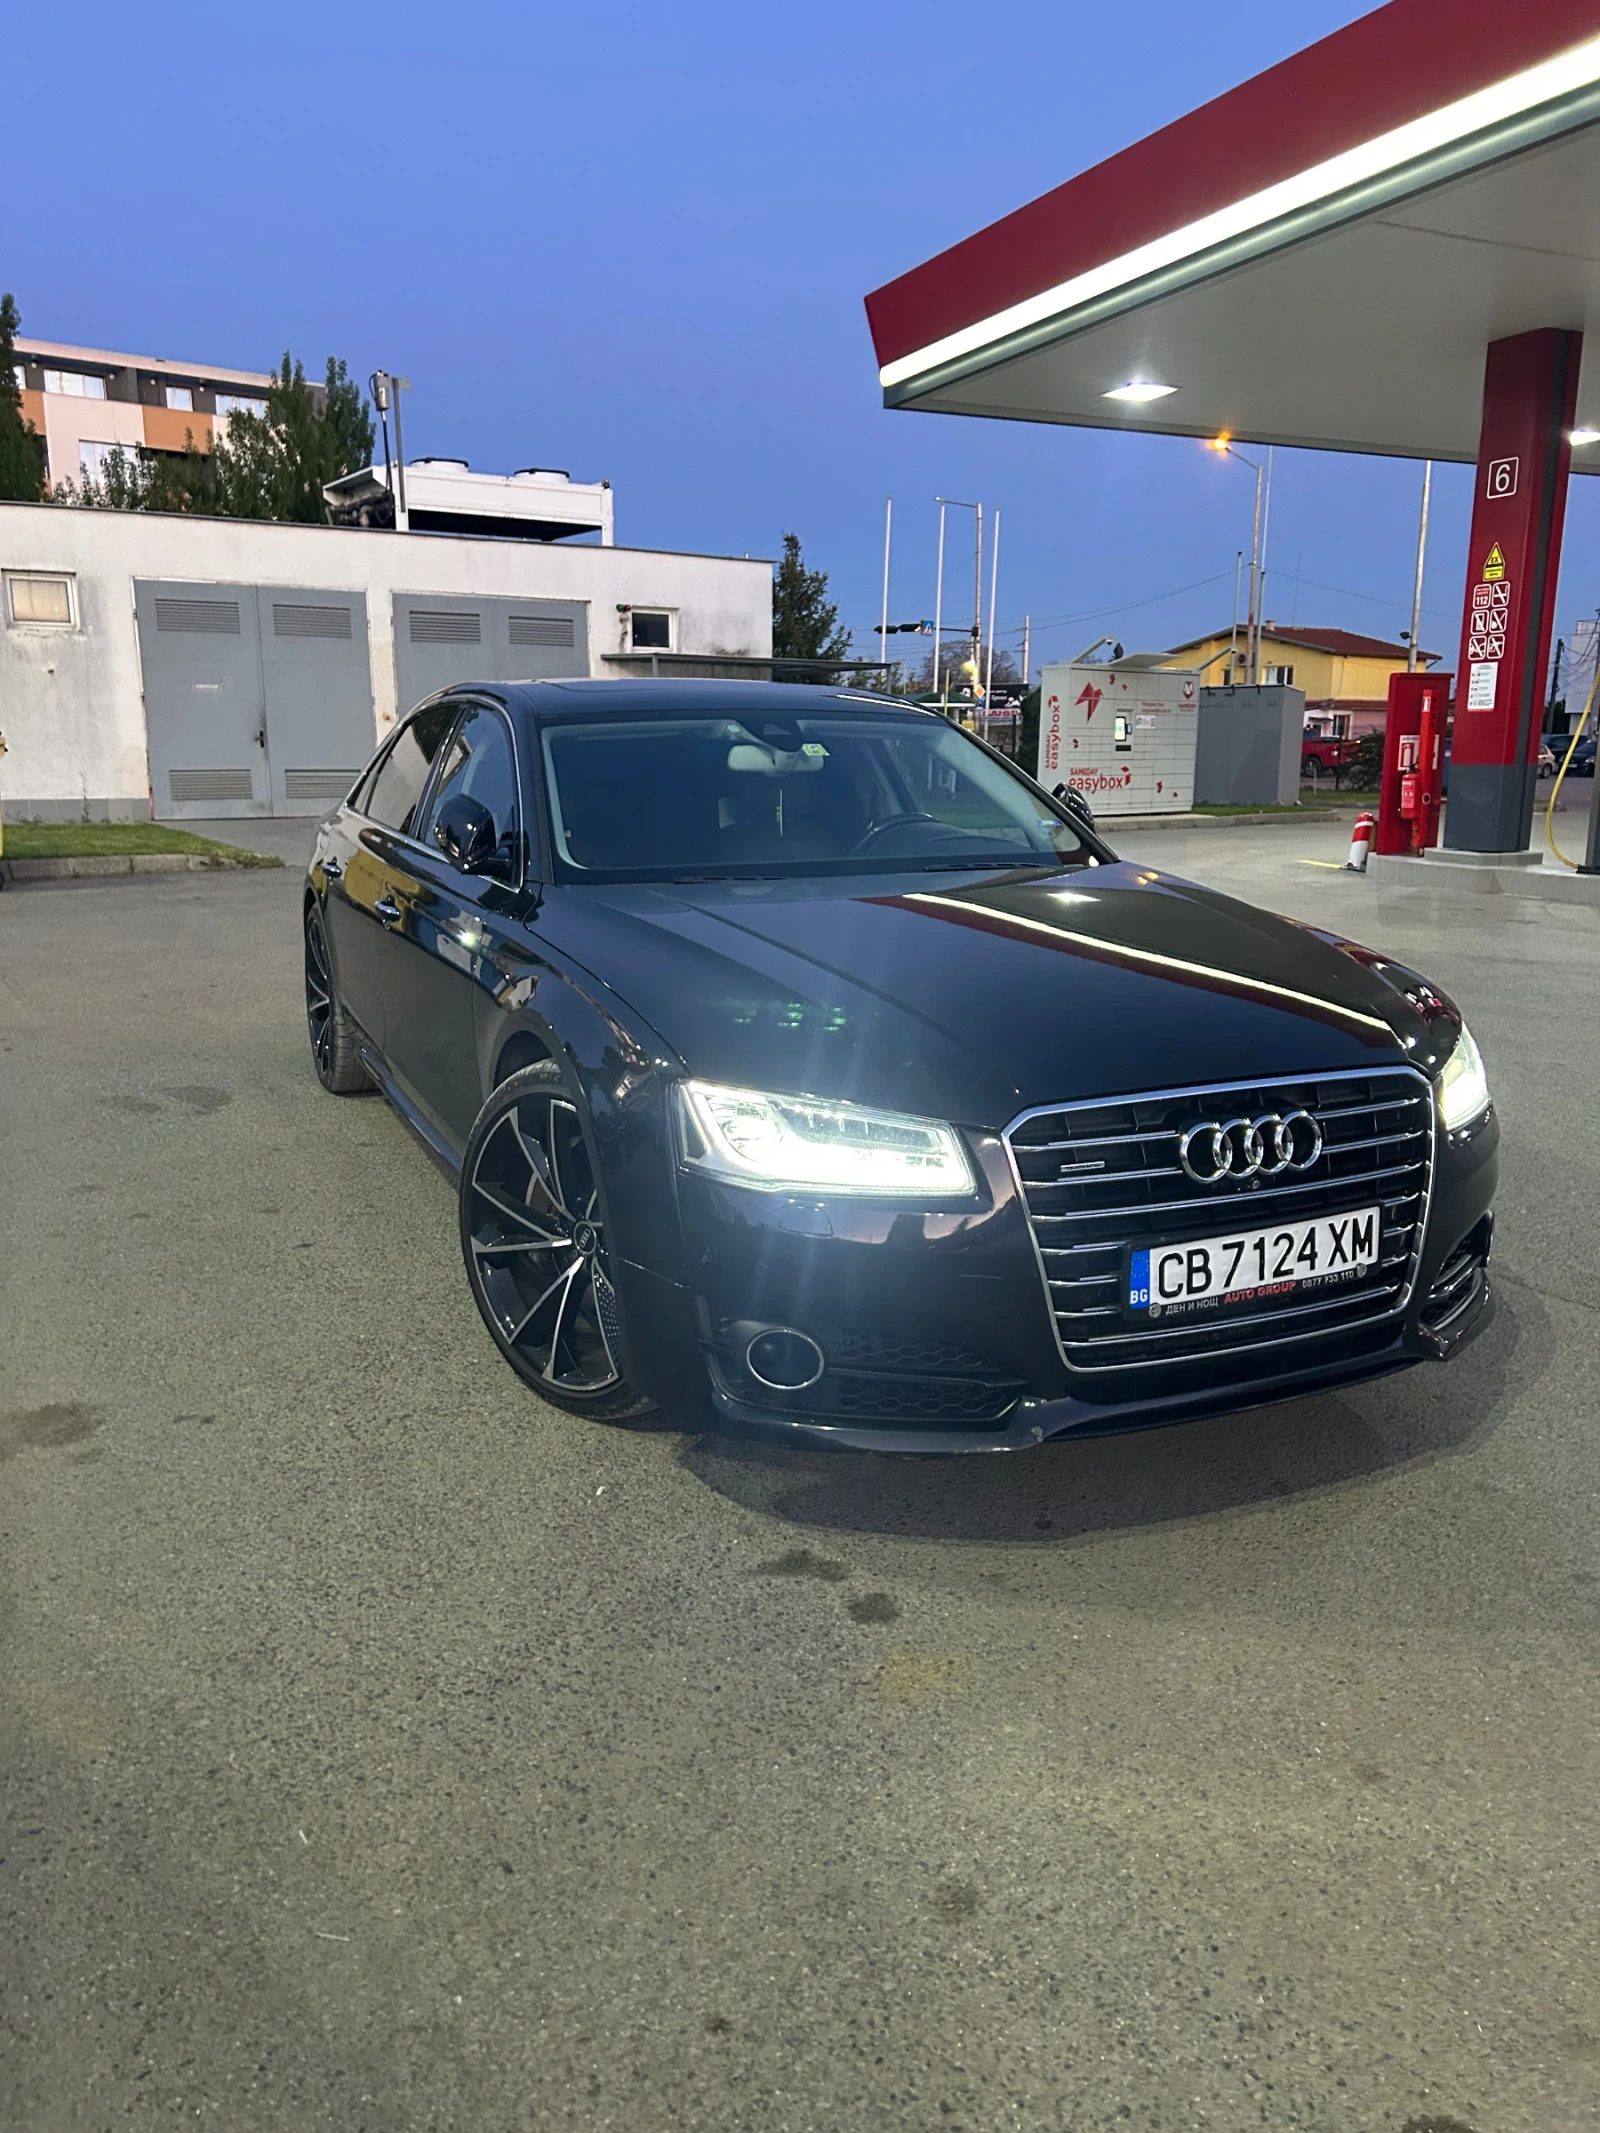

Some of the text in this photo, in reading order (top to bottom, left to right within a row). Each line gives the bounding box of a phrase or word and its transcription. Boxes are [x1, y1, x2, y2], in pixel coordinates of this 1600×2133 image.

[1495, 463, 1511, 492] 6
[1490, 556, 1499, 564] EX
[1476, 595, 1489, 606] 112
[1049, 705, 1061, 769] easybox
[1070, 767, 1098, 776] SAMEDAY
[1068, 773, 1123, 794] easybox
[1222, 1226, 1318, 1289] 7124
[1129, 1289, 1149, 1304] BG
[1165, 1270, 1354, 1316] ДЕН И НОЩ AUTO GROUP 0877 733 110
